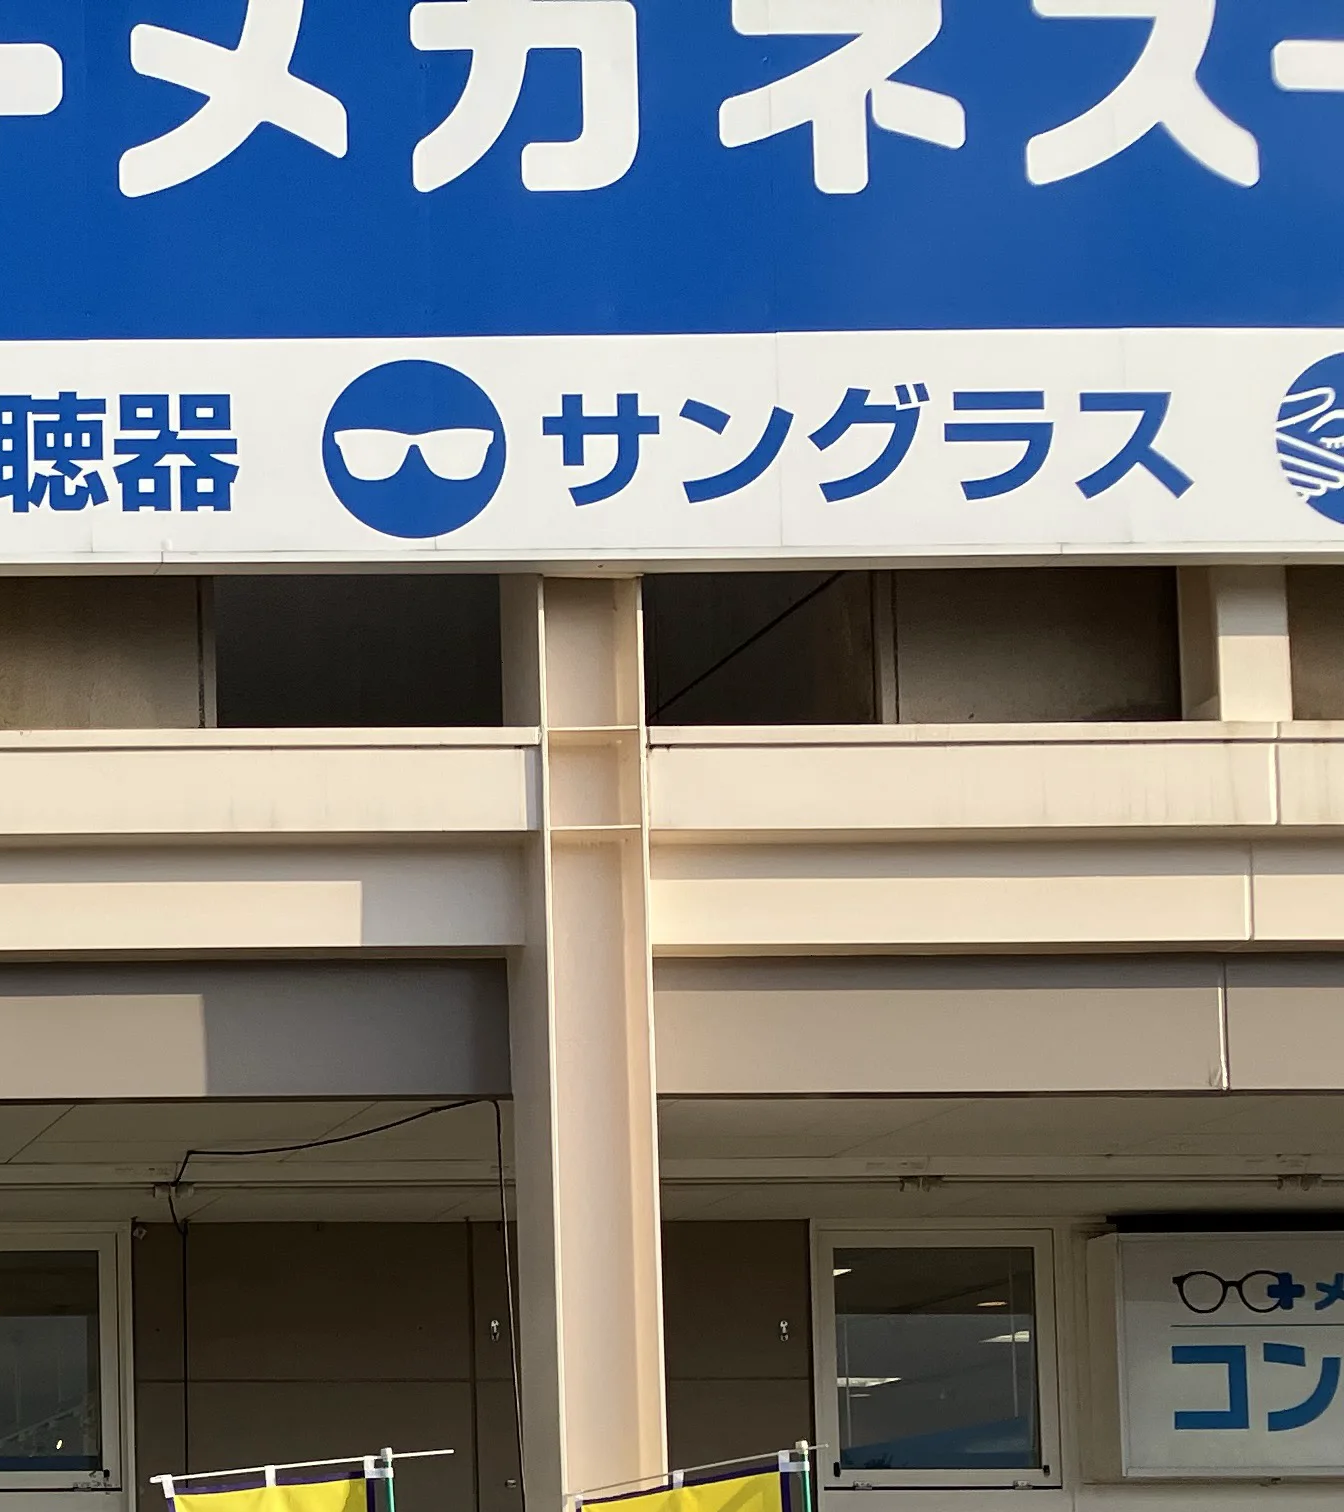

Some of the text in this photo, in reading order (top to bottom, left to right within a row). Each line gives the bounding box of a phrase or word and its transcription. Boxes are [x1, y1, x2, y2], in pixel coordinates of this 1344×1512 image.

[542, 382, 1194, 508] サングラス
[1171, 1341, 1341, 1432] コン
